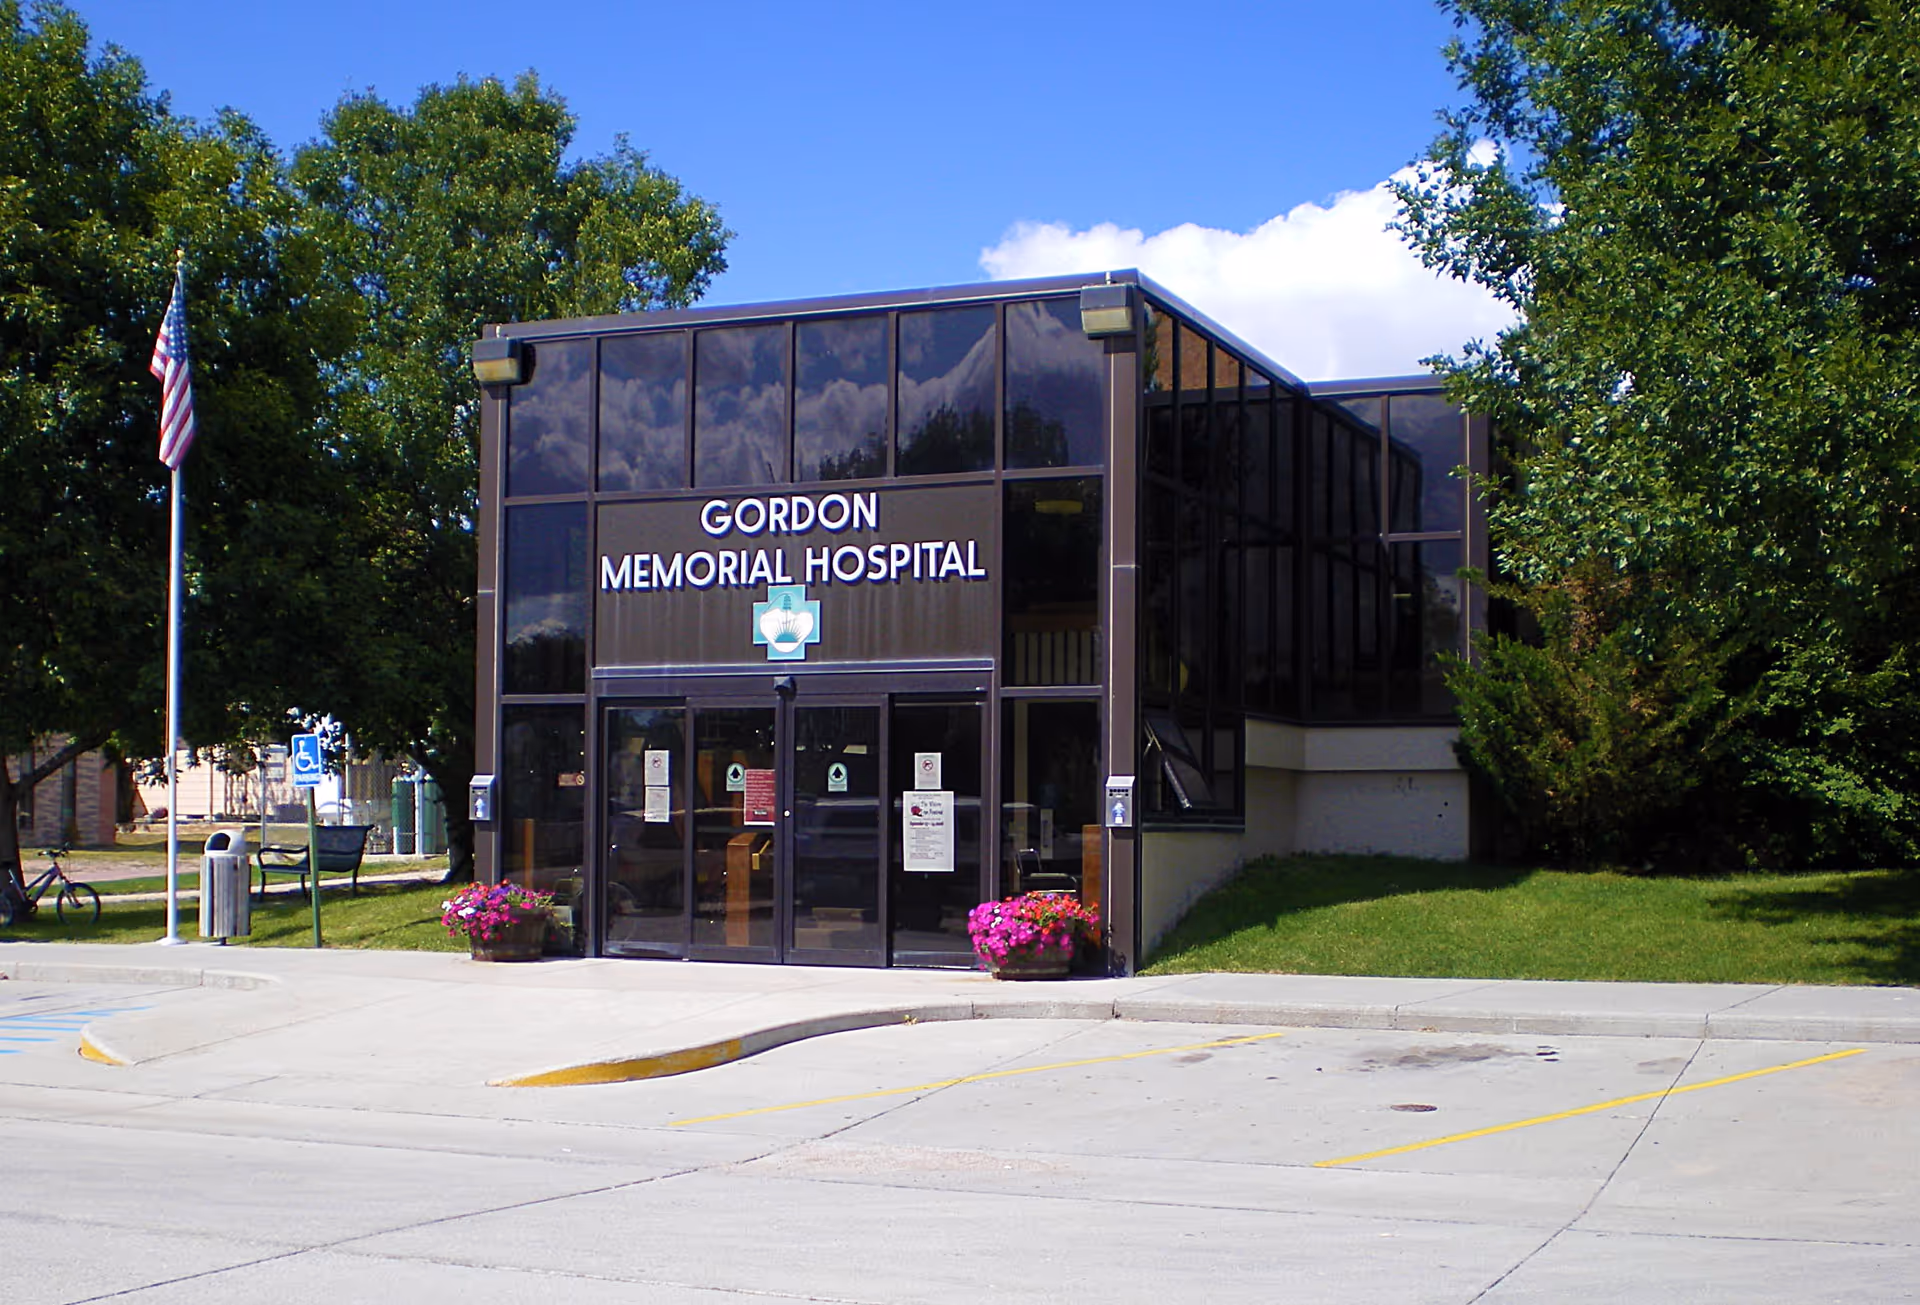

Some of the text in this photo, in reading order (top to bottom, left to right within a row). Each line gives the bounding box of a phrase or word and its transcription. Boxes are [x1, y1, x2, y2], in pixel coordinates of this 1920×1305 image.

[700, 492, 878, 535] GORDON
[600, 540, 987, 590] MEMORIAL HOSPITAL
